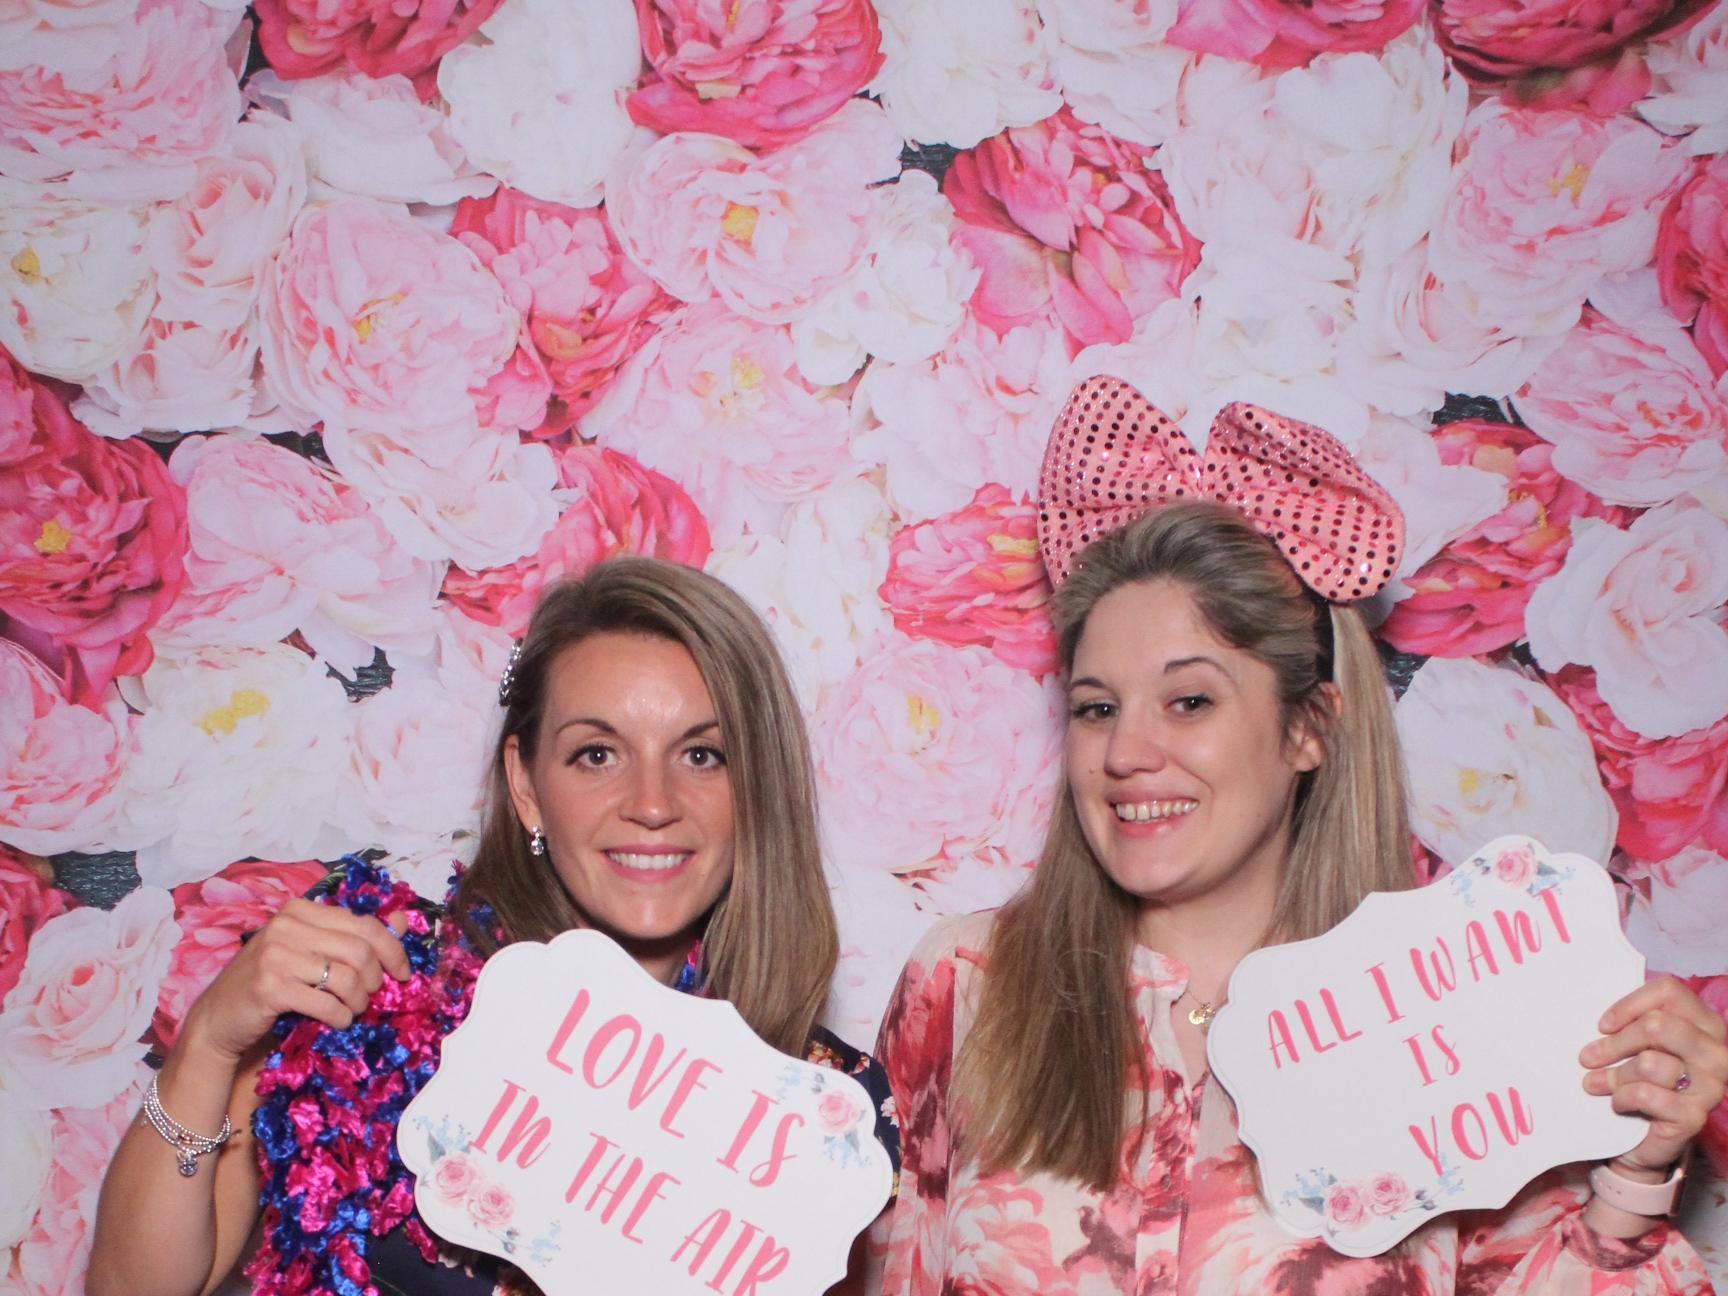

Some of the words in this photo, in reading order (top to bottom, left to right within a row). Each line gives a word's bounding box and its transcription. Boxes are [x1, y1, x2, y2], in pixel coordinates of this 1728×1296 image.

[1266, 988, 1363, 1069] ALL
[1364, 961, 1406, 1024] I
[1408, 883, 1571, 1002] WANT
[1401, 1023, 1461, 1087] IS
[468, 1079, 552, 1170] IN
[565, 1131, 682, 1245] THE
[546, 988, 723, 1139] LOVE
[716, 1089, 805, 1188] IS
[1408, 1086, 1534, 1176] YOU
